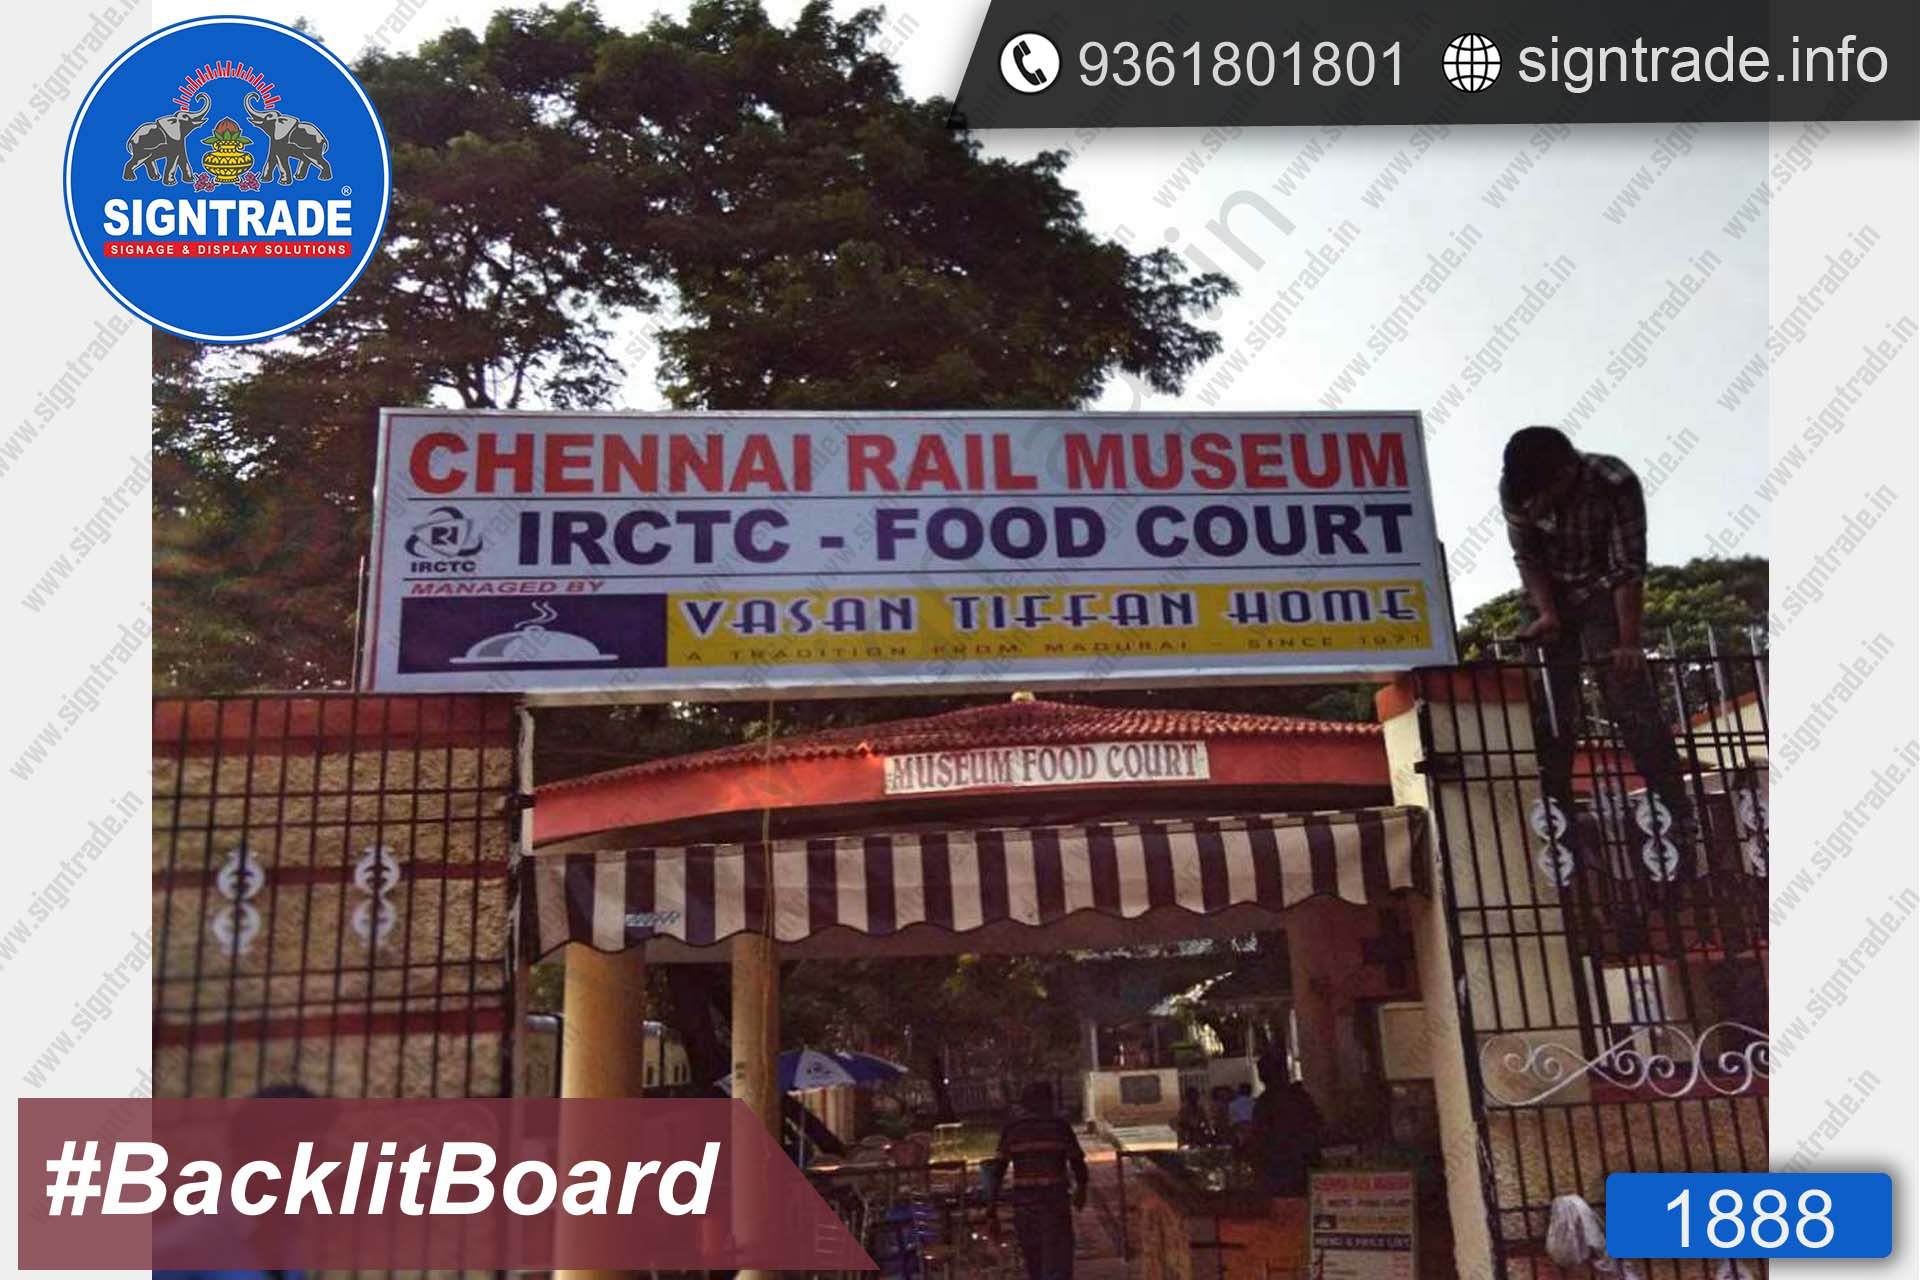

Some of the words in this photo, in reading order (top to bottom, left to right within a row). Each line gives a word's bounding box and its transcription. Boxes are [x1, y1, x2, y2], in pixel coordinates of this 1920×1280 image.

[409, 431, 812, 494] CHENNAI
[846, 433, 1038, 492] RAIL
[1064, 432, 1408, 491] MUSEUM
[518, 509, 790, 566] IRCTC
[819, 535, 845, 549] -
[875, 506, 1106, 562] FOOD
[1136, 504, 1413, 558] COURT
[411, 560, 477, 574] IRCTC
[411, 581, 557, 595] MANAGED
[565, 580, 605, 593] BY
[684, 596, 914, 636] VASAN
[950, 592, 1195, 629] TIFFAN
[1227, 588, 1417, 624] HOME
[687, 650, 701, 661] A
[731, 646, 906, 661] TRADITION
[933, 642, 1020, 657] FROM
[1045, 640, 1188, 653] MADURAI
[1248, 636, 1335, 650] SINCE
[890, 750, 1014, 791] MUSEUM
[1022, 745, 1098, 782] FOOD
[1106, 743, 1199, 778] COURT
